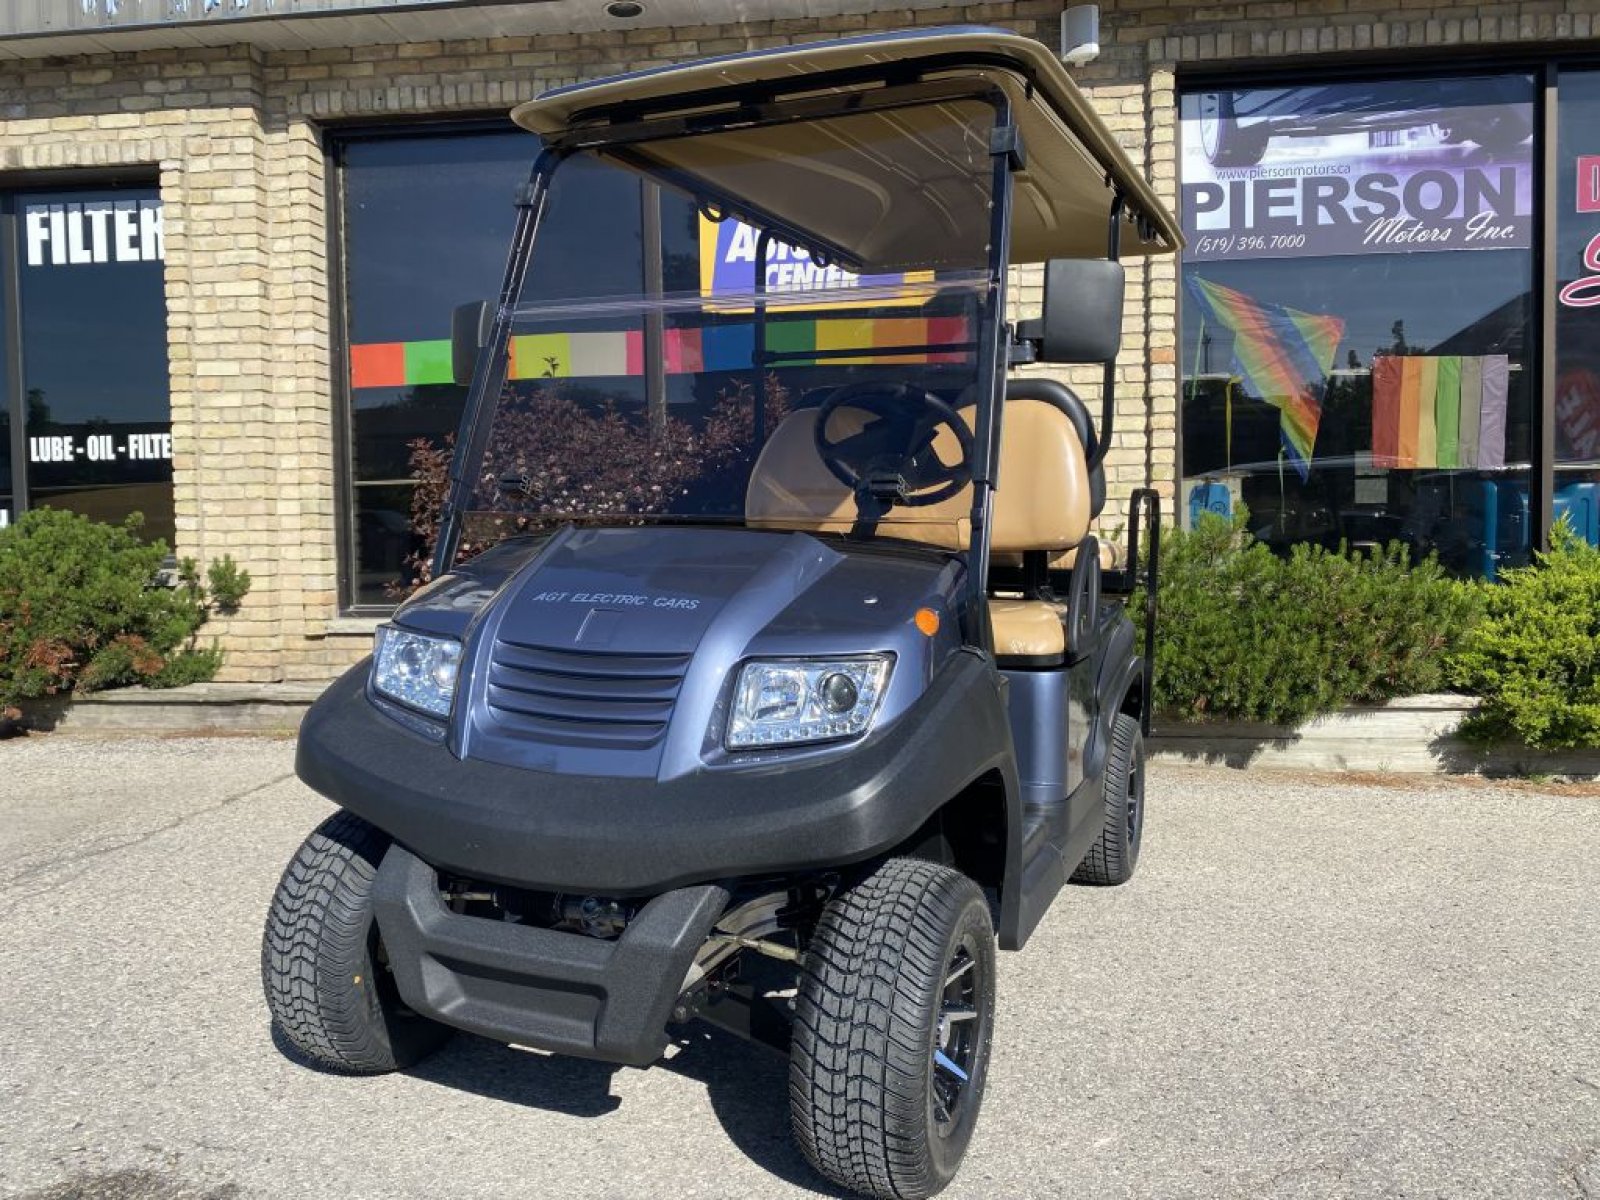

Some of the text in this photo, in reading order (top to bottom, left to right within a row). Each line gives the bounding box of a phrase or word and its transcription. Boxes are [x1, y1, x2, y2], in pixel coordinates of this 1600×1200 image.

[1215, 164, 1351, 181] www.piersonmotors.ca
[1182, 166, 1517, 231] PIERSON
[1363, 210, 1515, 245] Motors Inc.
[1195, 233, 1306, 255] (519) 396.7000
[30, 435, 75, 462] LUBE
[86, 434, 117, 461] OIL
[532, 591, 701, 610] AGT ELECTRIC CARS
